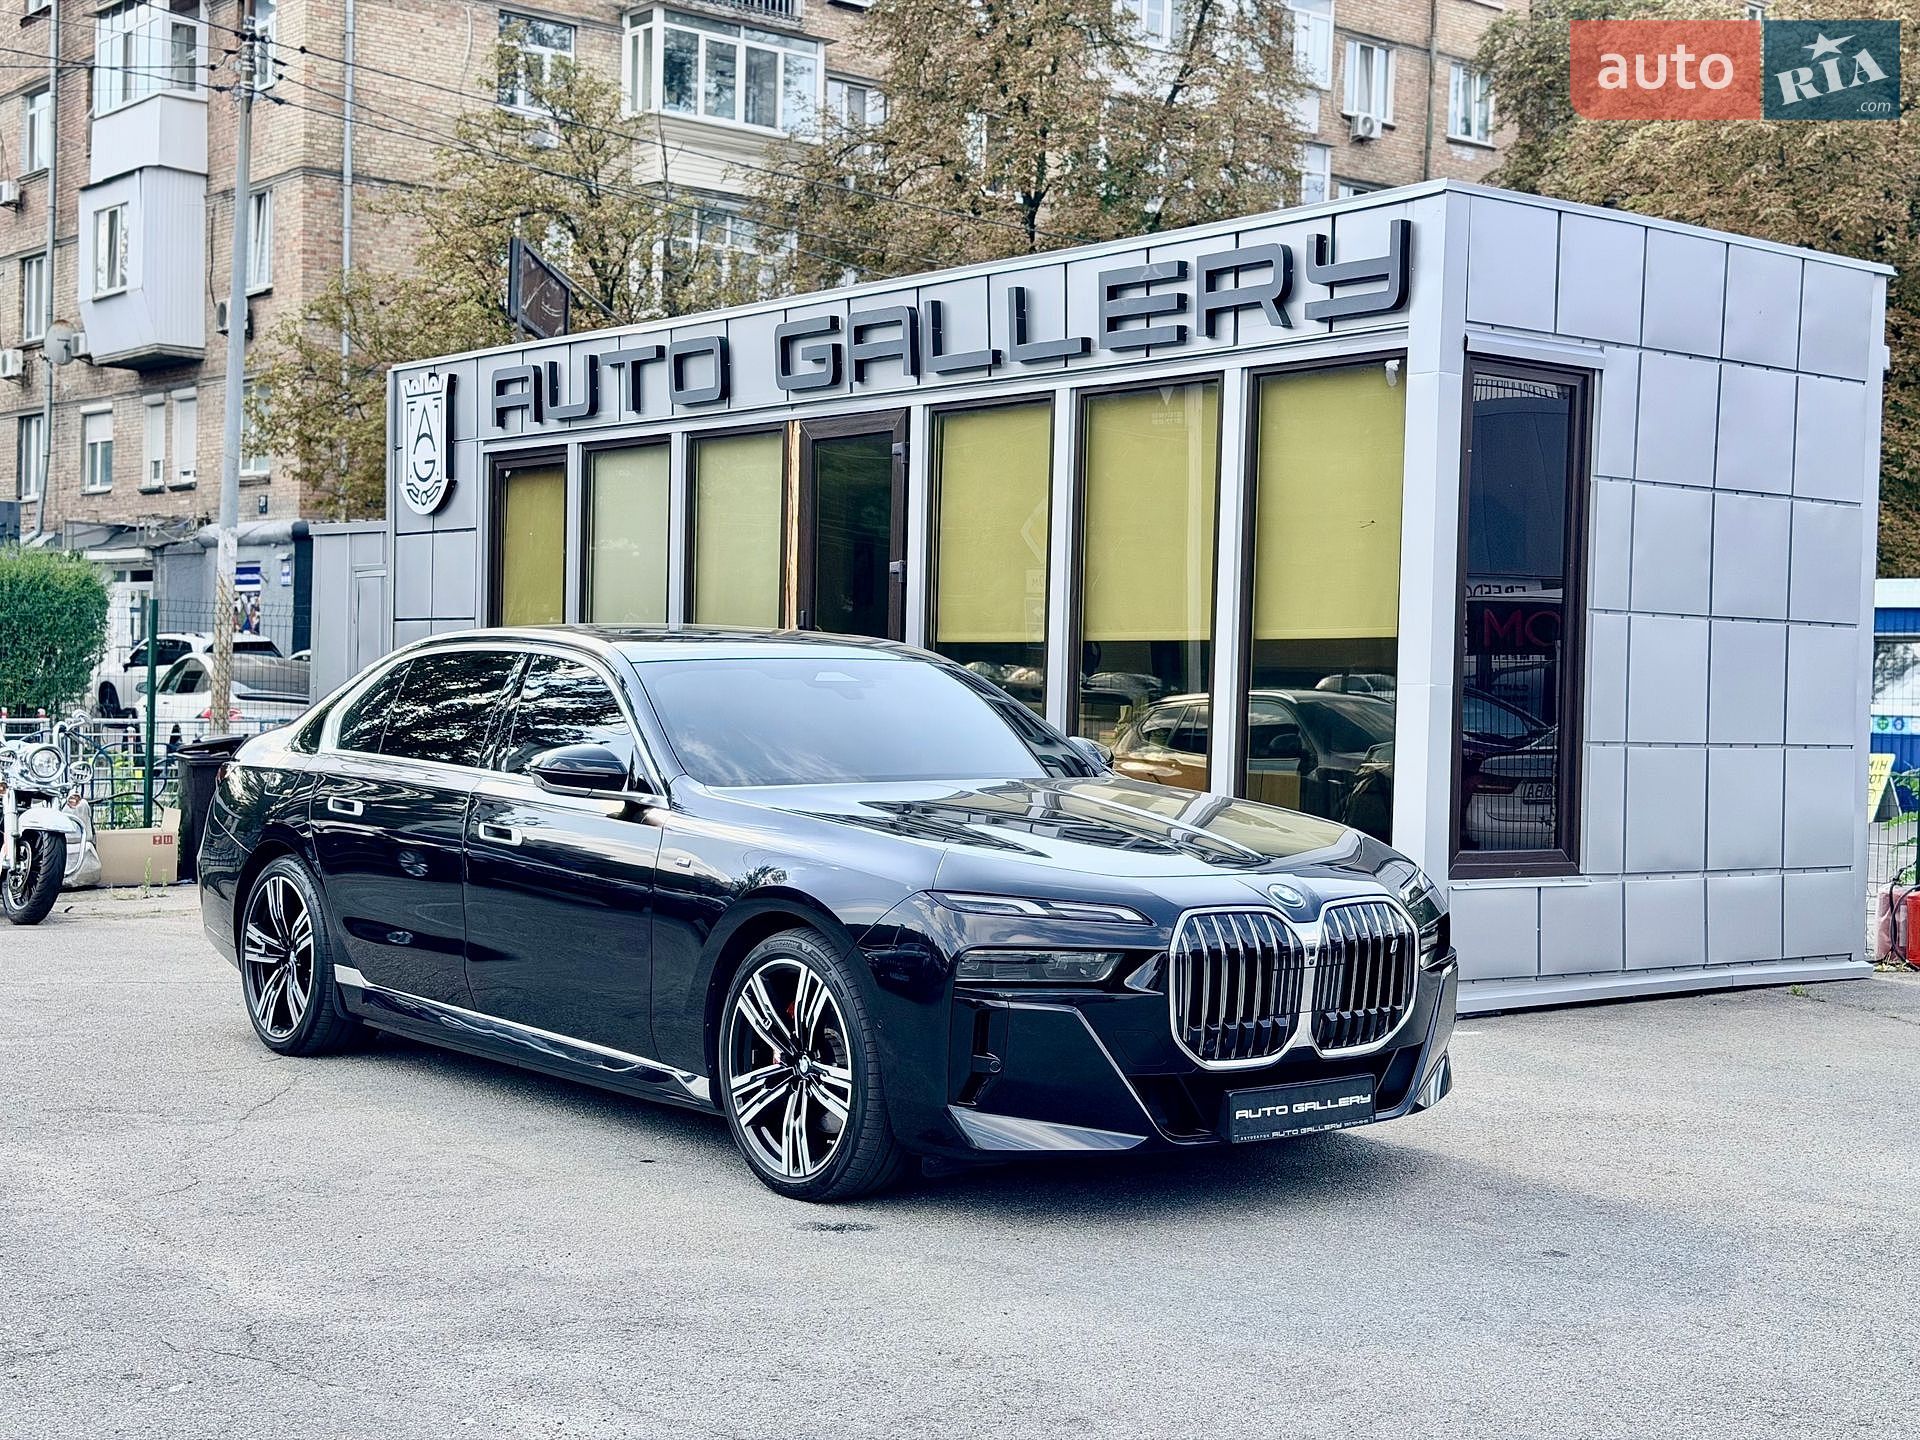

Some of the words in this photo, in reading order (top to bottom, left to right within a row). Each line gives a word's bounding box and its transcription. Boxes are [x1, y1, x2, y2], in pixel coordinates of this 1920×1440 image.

[491, 336, 730, 428] AUTO
[774, 219, 1411, 391] GALLERY
[1235, 1105, 1289, 1120] AUTO
[1292, 1093, 1372, 1113] GALLERY
[1271, 1129, 1299, 1138] AUTO
[1300, 1122, 1342, 1134] GALLERY
